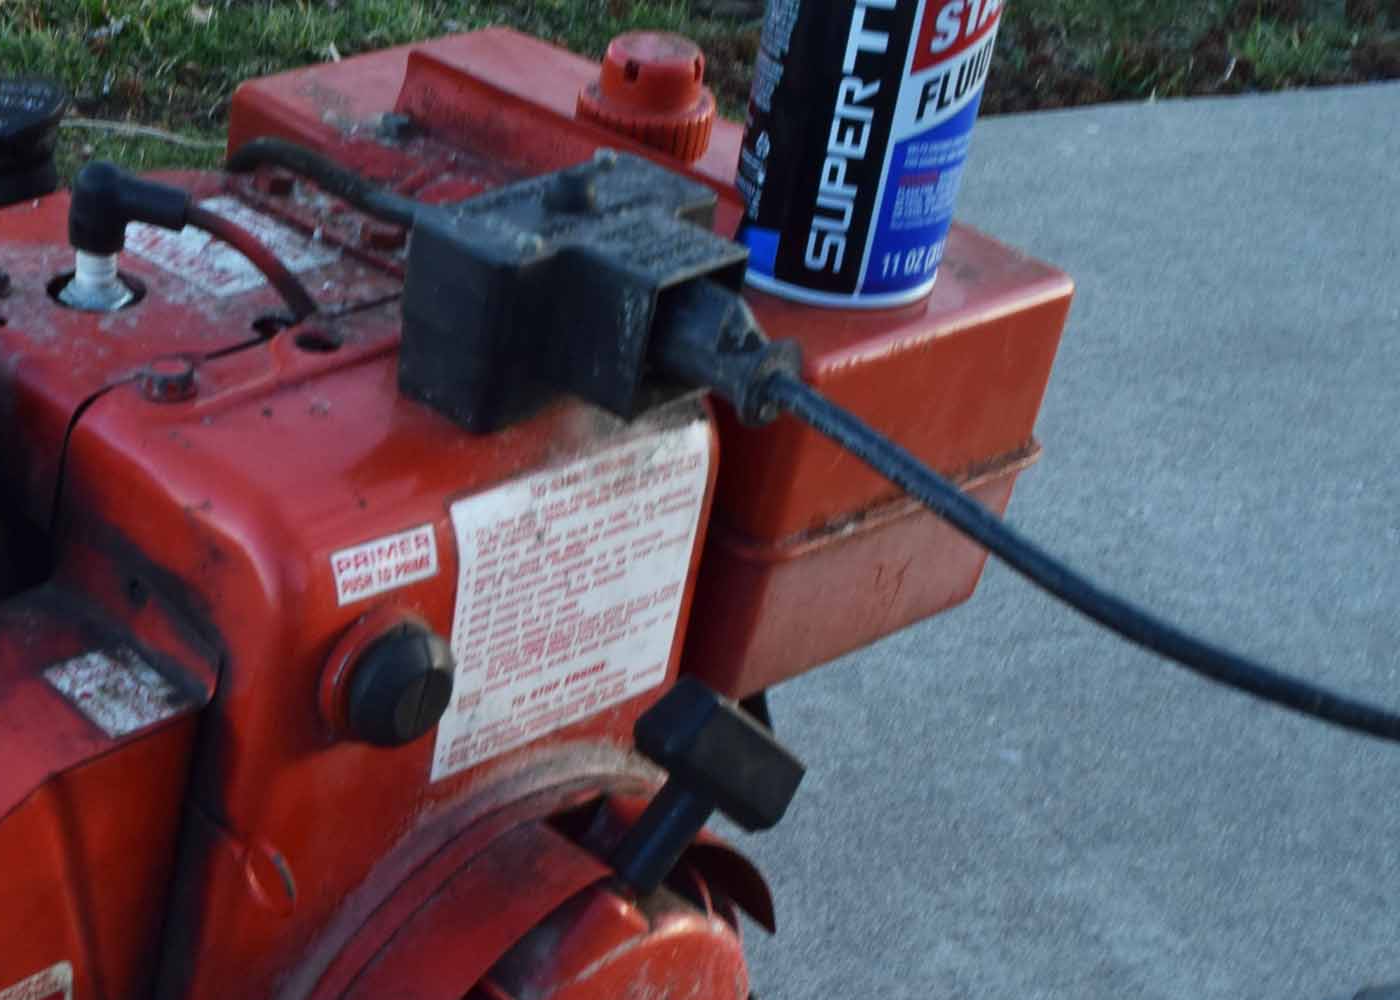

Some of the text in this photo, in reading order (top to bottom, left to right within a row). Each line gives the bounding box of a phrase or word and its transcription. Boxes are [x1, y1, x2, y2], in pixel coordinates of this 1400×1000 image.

[915, 38, 993, 123] FLUID
[804, 0, 897, 274] SUPERT
[882, 252, 900, 279] 11
[904, 244, 926, 274] OZ
[336, 532, 430, 575] PRIMER
